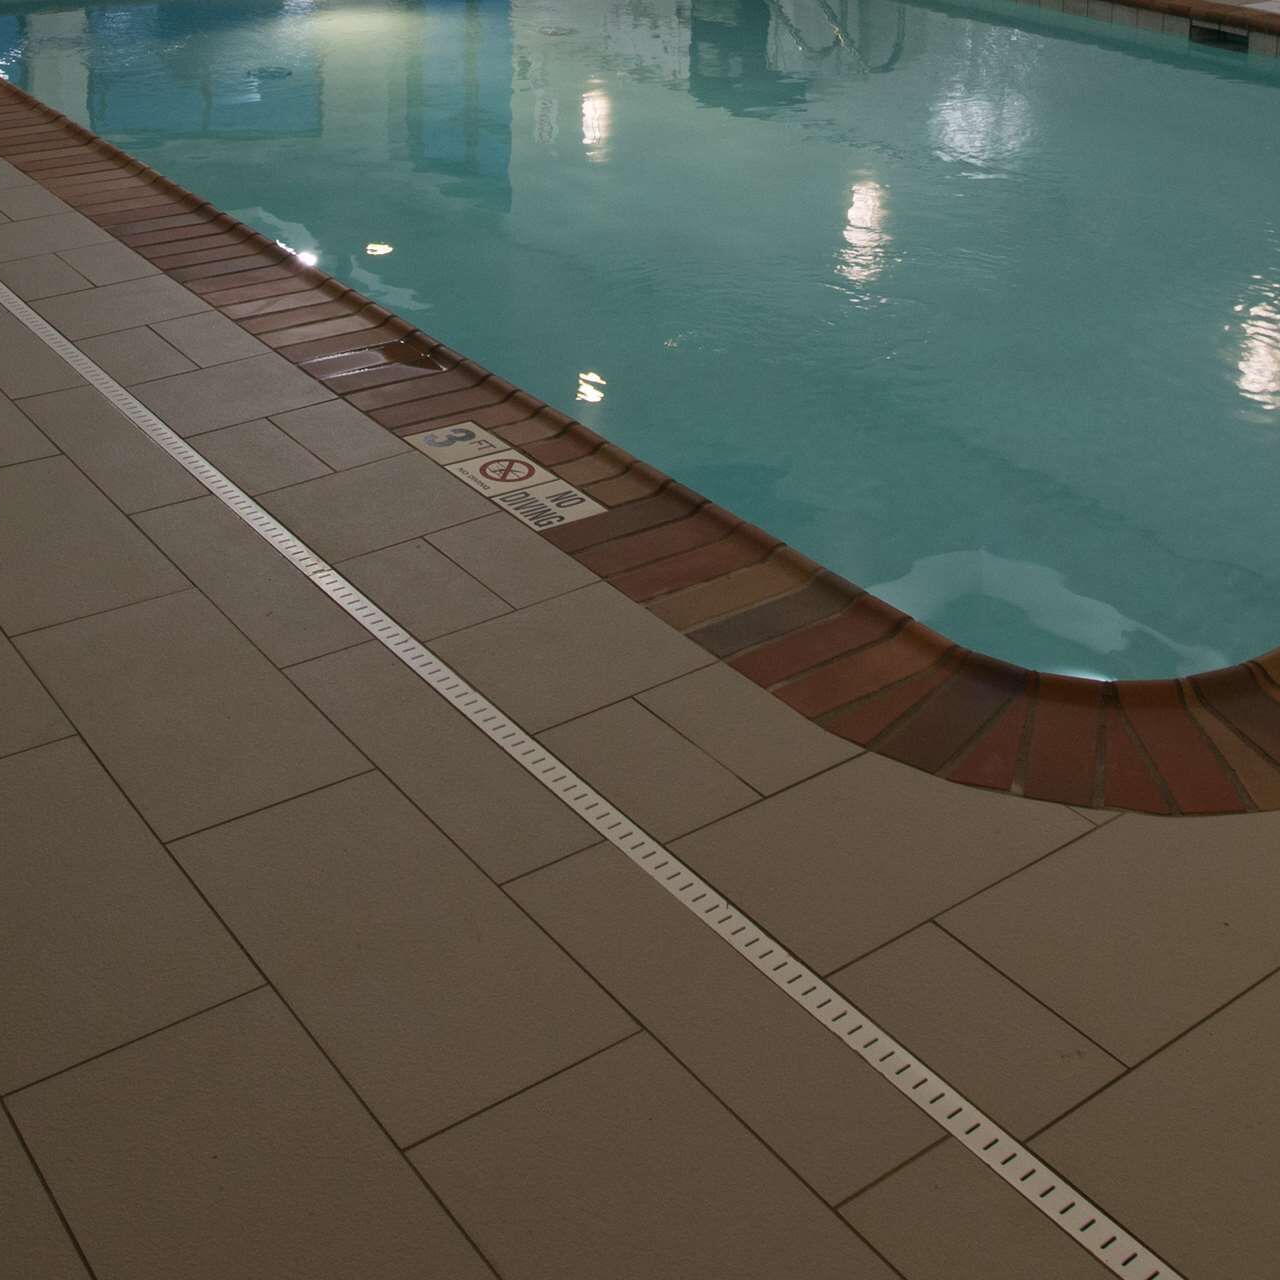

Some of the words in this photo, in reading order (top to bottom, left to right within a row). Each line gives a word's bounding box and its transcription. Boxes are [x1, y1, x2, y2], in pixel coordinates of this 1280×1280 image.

[423, 428, 476, 448] 3
[470, 439, 497, 451] FT
[499, 490, 565, 528] DIVING
[546, 490, 587, 509] NO
